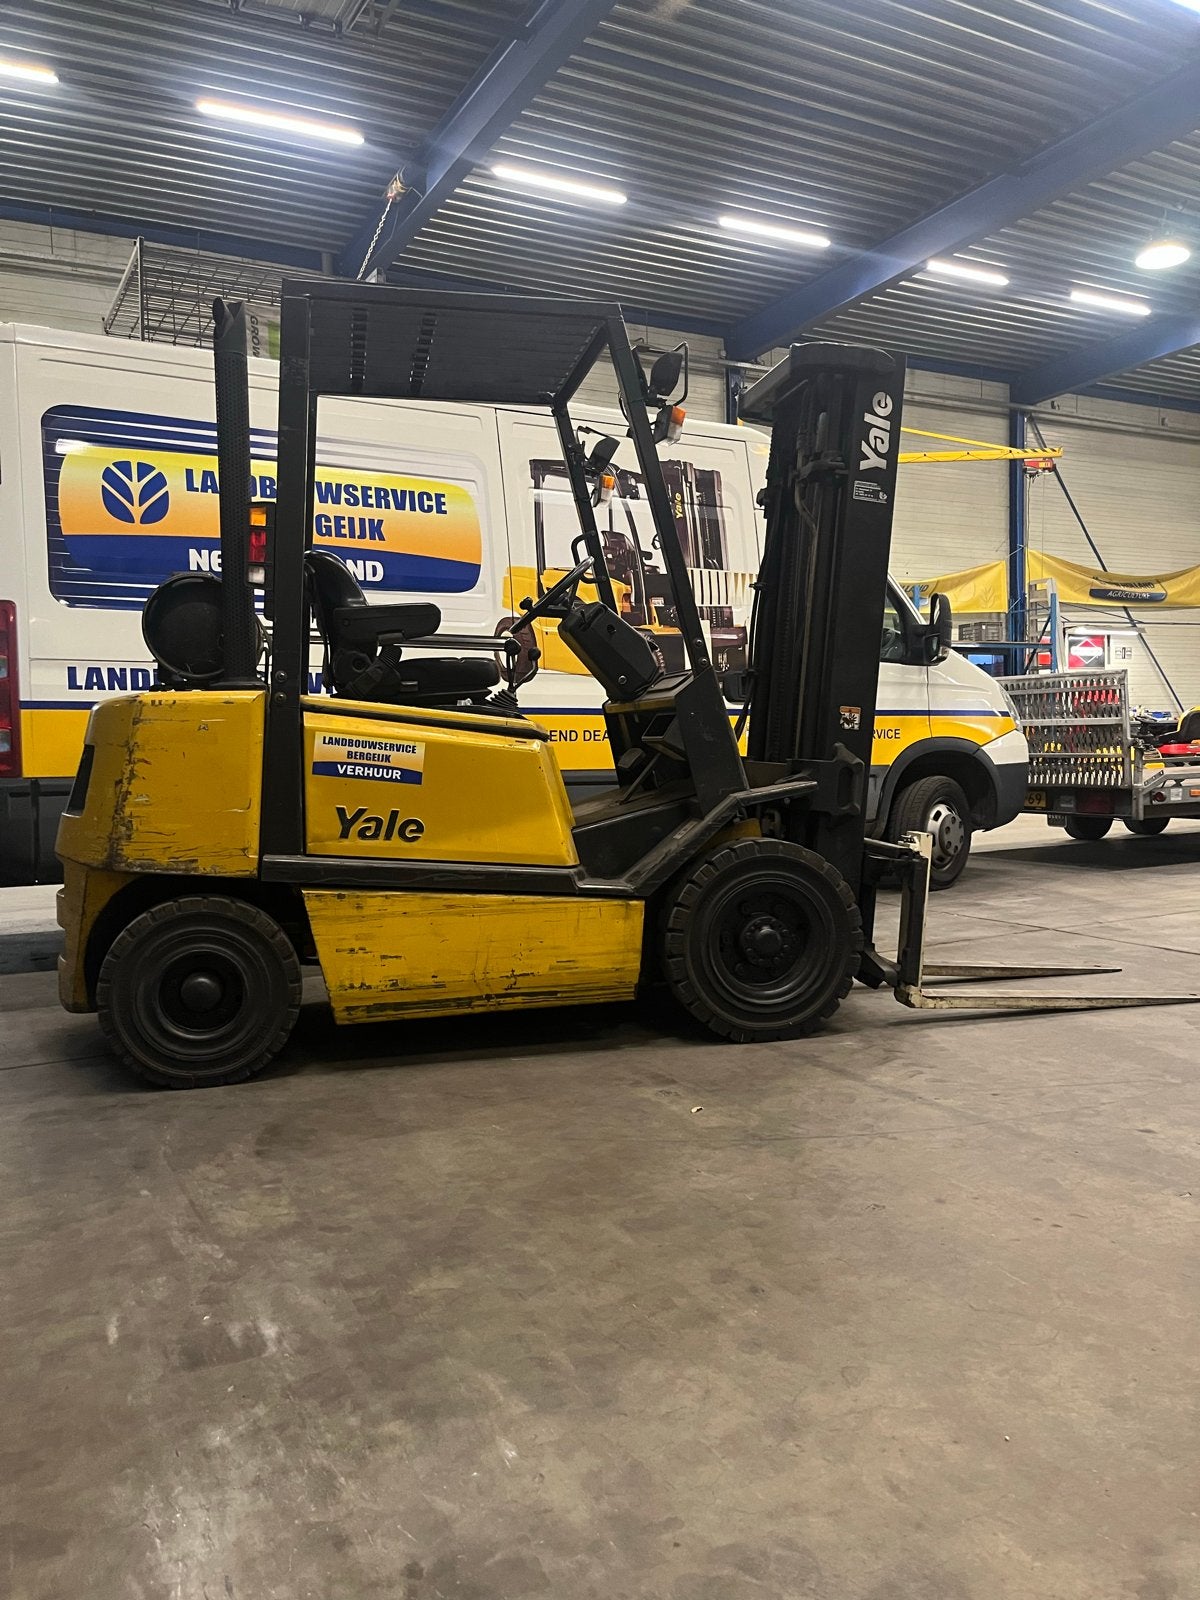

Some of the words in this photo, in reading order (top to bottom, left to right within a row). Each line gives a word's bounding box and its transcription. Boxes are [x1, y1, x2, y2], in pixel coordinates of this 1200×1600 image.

[859, 391, 893, 471] Yale
[185, 468, 448, 515] LABWSERVICE
[674, 492, 684, 519] Yale
[314, 513, 386, 542] GEIJK
[322, 735, 417, 754] LANDBOUWSERVICE
[549, 729, 579, 742] END
[873, 728, 901, 740] VICE
[346, 750, 392, 763] BERGEIJK
[337, 764, 402, 780] VERHUUR
[335, 805, 426, 843] Yale
